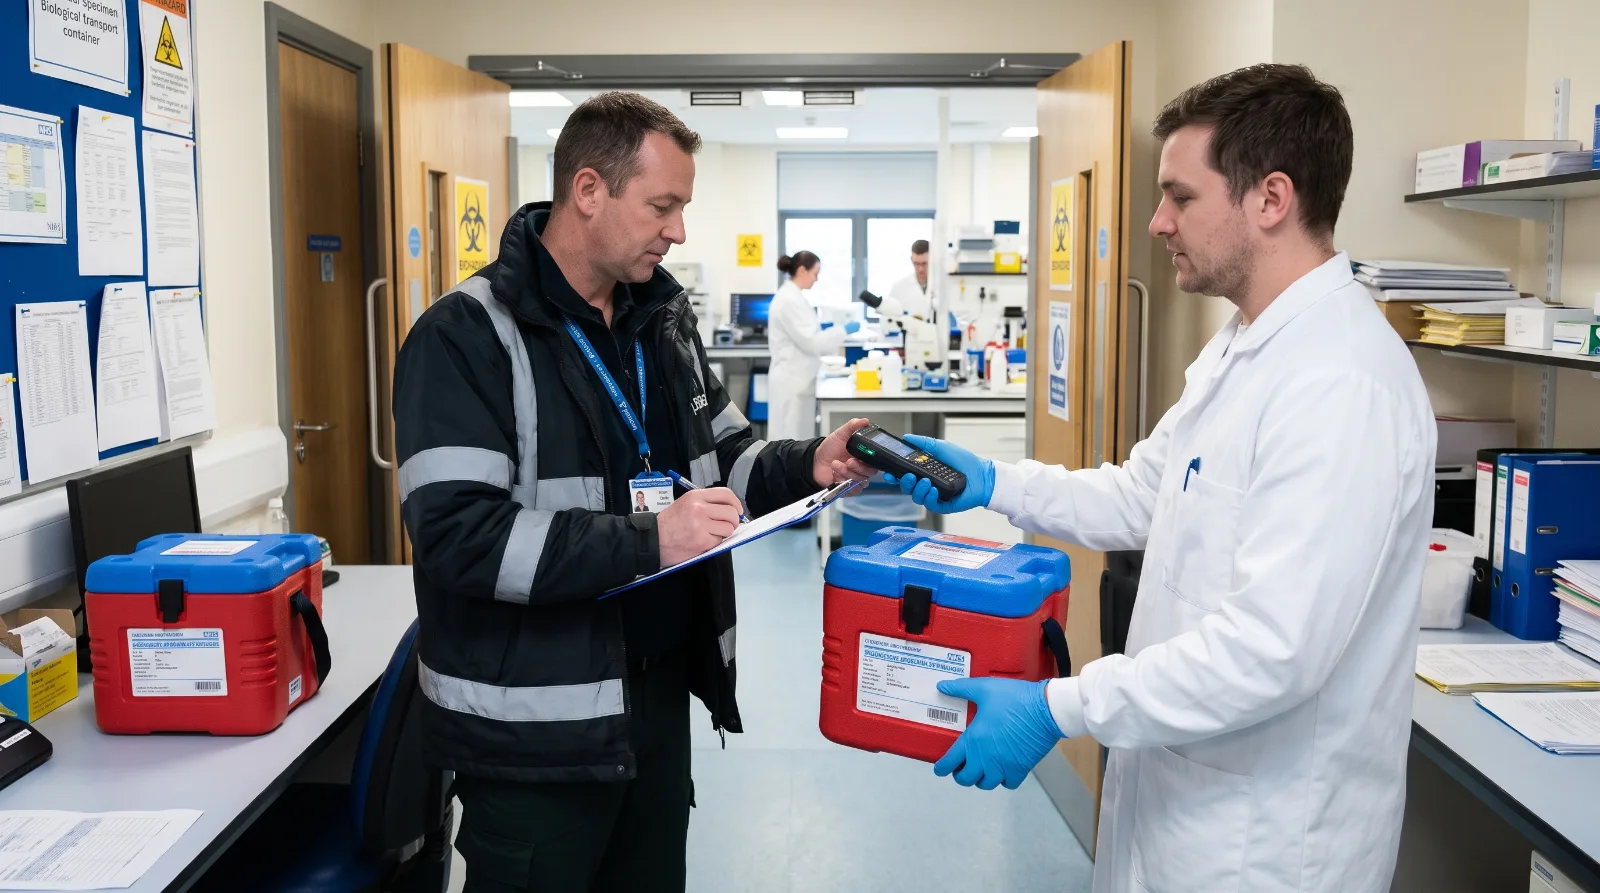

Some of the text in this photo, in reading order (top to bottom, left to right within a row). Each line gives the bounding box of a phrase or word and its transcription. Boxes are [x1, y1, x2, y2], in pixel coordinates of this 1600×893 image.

[41, 0, 119, 35] Biological transport
[82, 0, 119, 18] Specimen
[63, 27, 100, 46] container
